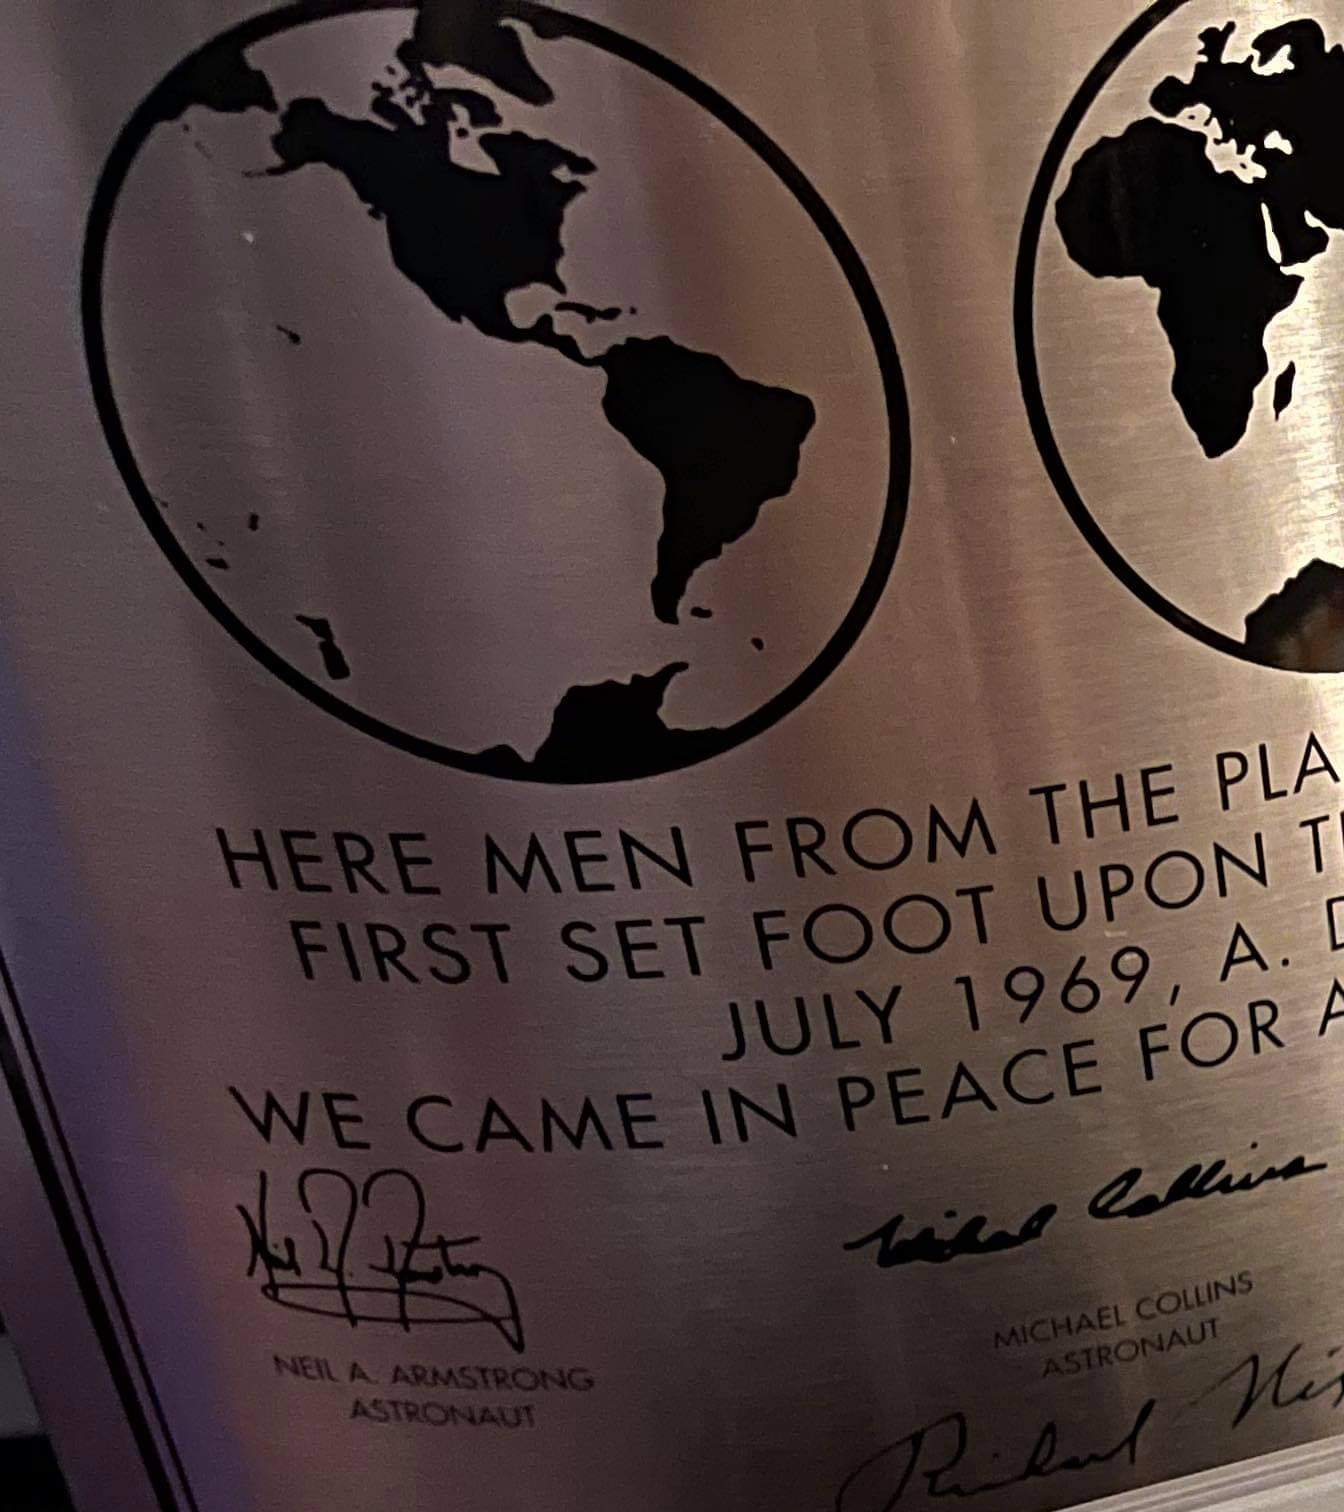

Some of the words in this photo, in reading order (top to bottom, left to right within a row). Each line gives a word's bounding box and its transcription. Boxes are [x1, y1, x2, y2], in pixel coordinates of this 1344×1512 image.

[215, 827, 442, 896] HERE
[484, 825, 694, 896] MEN
[734, 797, 999, 883] FROM
[1029, 764, 1179, 845] THE
[288, 919, 512, 985] FIRST
[559, 916, 706, 984] SET
[752, 884, 995, 971] FOOT
[1037, 831, 1268, 932] UPON
[721, 984, 903, 1062] JULY
[954, 945, 1181, 1032] 1969,
[1218, 923, 1290, 984] A.
[228, 1085, 372, 1152] WE
[405, 1091, 665, 1155] CAME
[700, 1082, 798, 1146] IN
[836, 1039, 1104, 1133] PEACE
[1137, 999, 1286, 1082] FOR
[993, 1304, 1126, 1350] MICHAEL
[1135, 1269, 1255, 1322] COLLINS
[1041, 1316, 1220, 1378] ASTRONAUT
[271, 1353, 336, 1384] NEIL
[390, 1363, 596, 1393] ARMSTRONG
[349, 1399, 537, 1429] ASTRONAUT
